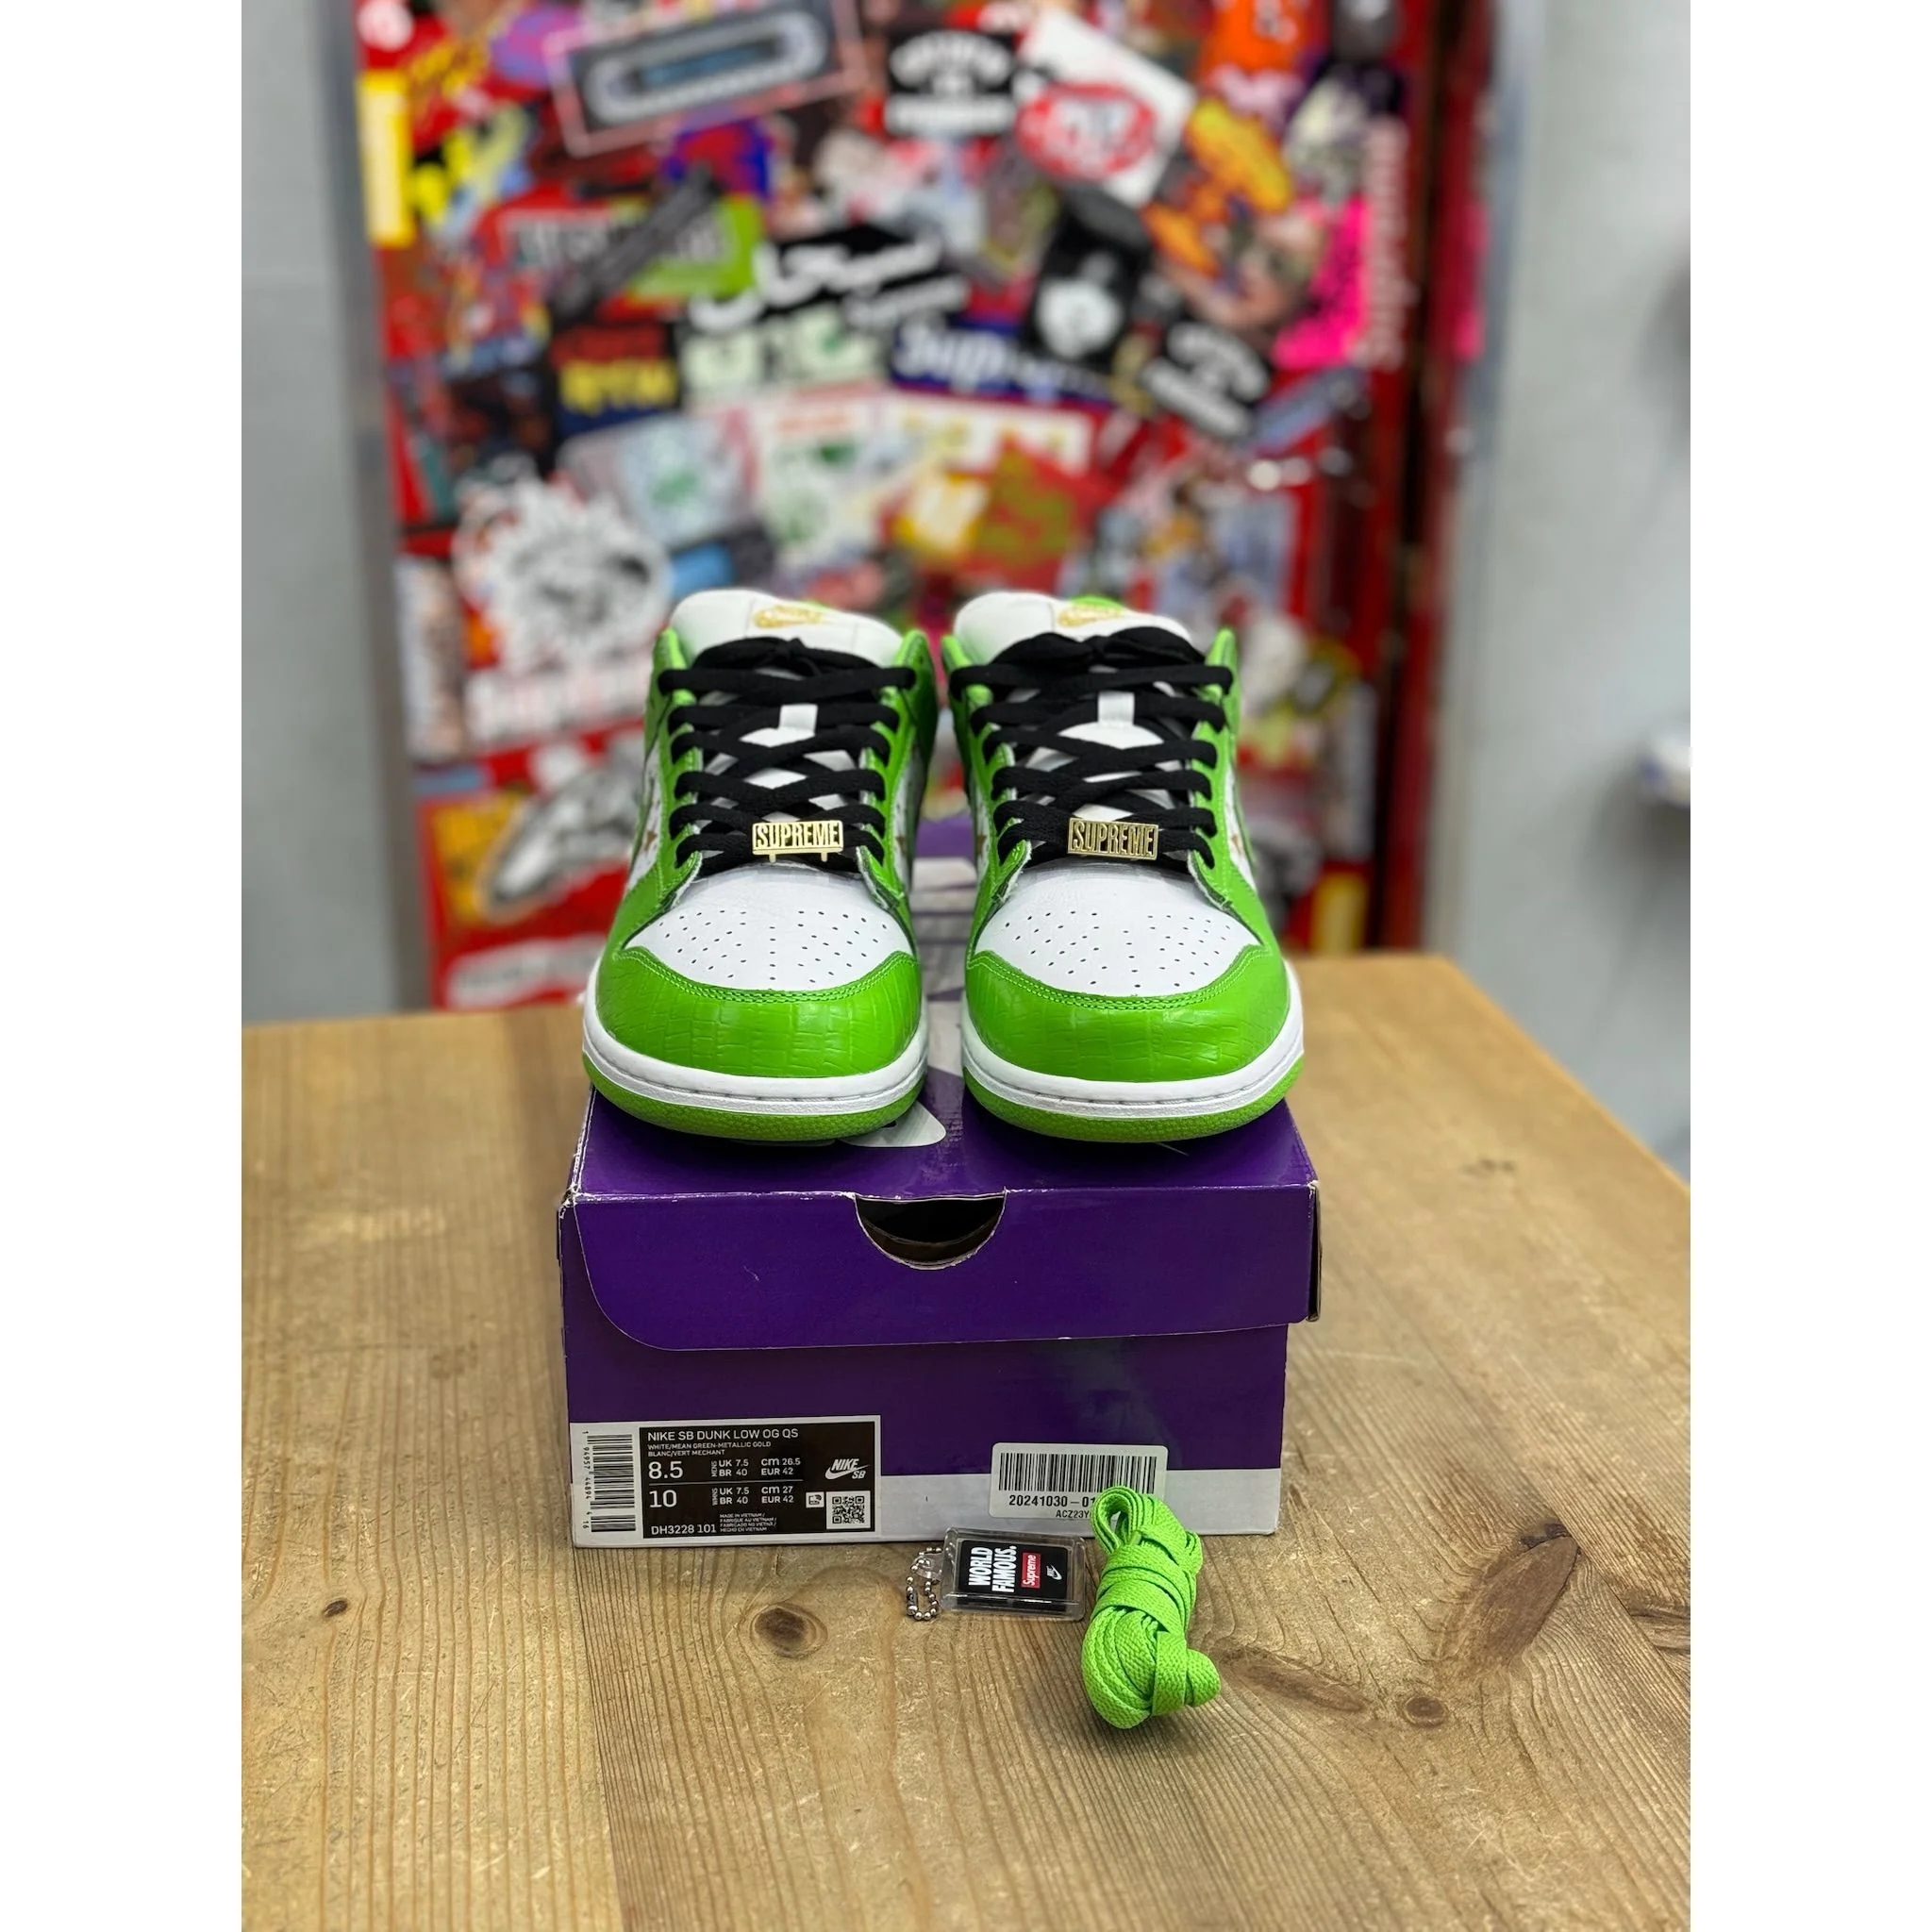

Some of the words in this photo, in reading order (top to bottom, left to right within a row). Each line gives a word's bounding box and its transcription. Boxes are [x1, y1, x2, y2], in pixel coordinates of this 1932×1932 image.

[756, 822, 840, 848] SUPREME
[1072, 820, 1156, 858] SUPREME
[647, 1431, 675, 1441] NIKE
[678, 1430, 694, 1441] SB
[696, 1429, 731, 1441] DUNK
[733, 1429, 760, 1440] LOW
[762, 1428, 779, 1439] OG
[782, 1428, 799, 1439] QS
[736, 1458, 749, 1467] 7.5
[782, 1457, 801, 1466] 26.5
[831, 1458, 859, 1471] NIKE
[648, 1460, 683, 1479] 8.5
[736, 1468, 748, 1476] 40
[782, 1467, 794, 1475] 42
[852, 1470, 866, 1479] SB
[719, 1487, 733, 1495] UK
[736, 1486, 750, 1494] 7.5
[761, 1486, 780, 1494] cm
[649, 1490, 677, 1508] 10
[737, 1496, 749, 1505] 40
[761, 1495, 781, 1504] EUR
[651, 1524, 694, 1535] DH3228
[696, 1524, 717, 1534] 101
[968, 1547, 993, 1586] WORLD
[991, 1545, 1018, 1593] FAMOUS.
[1022, 1555, 1038, 1586] Supreme
